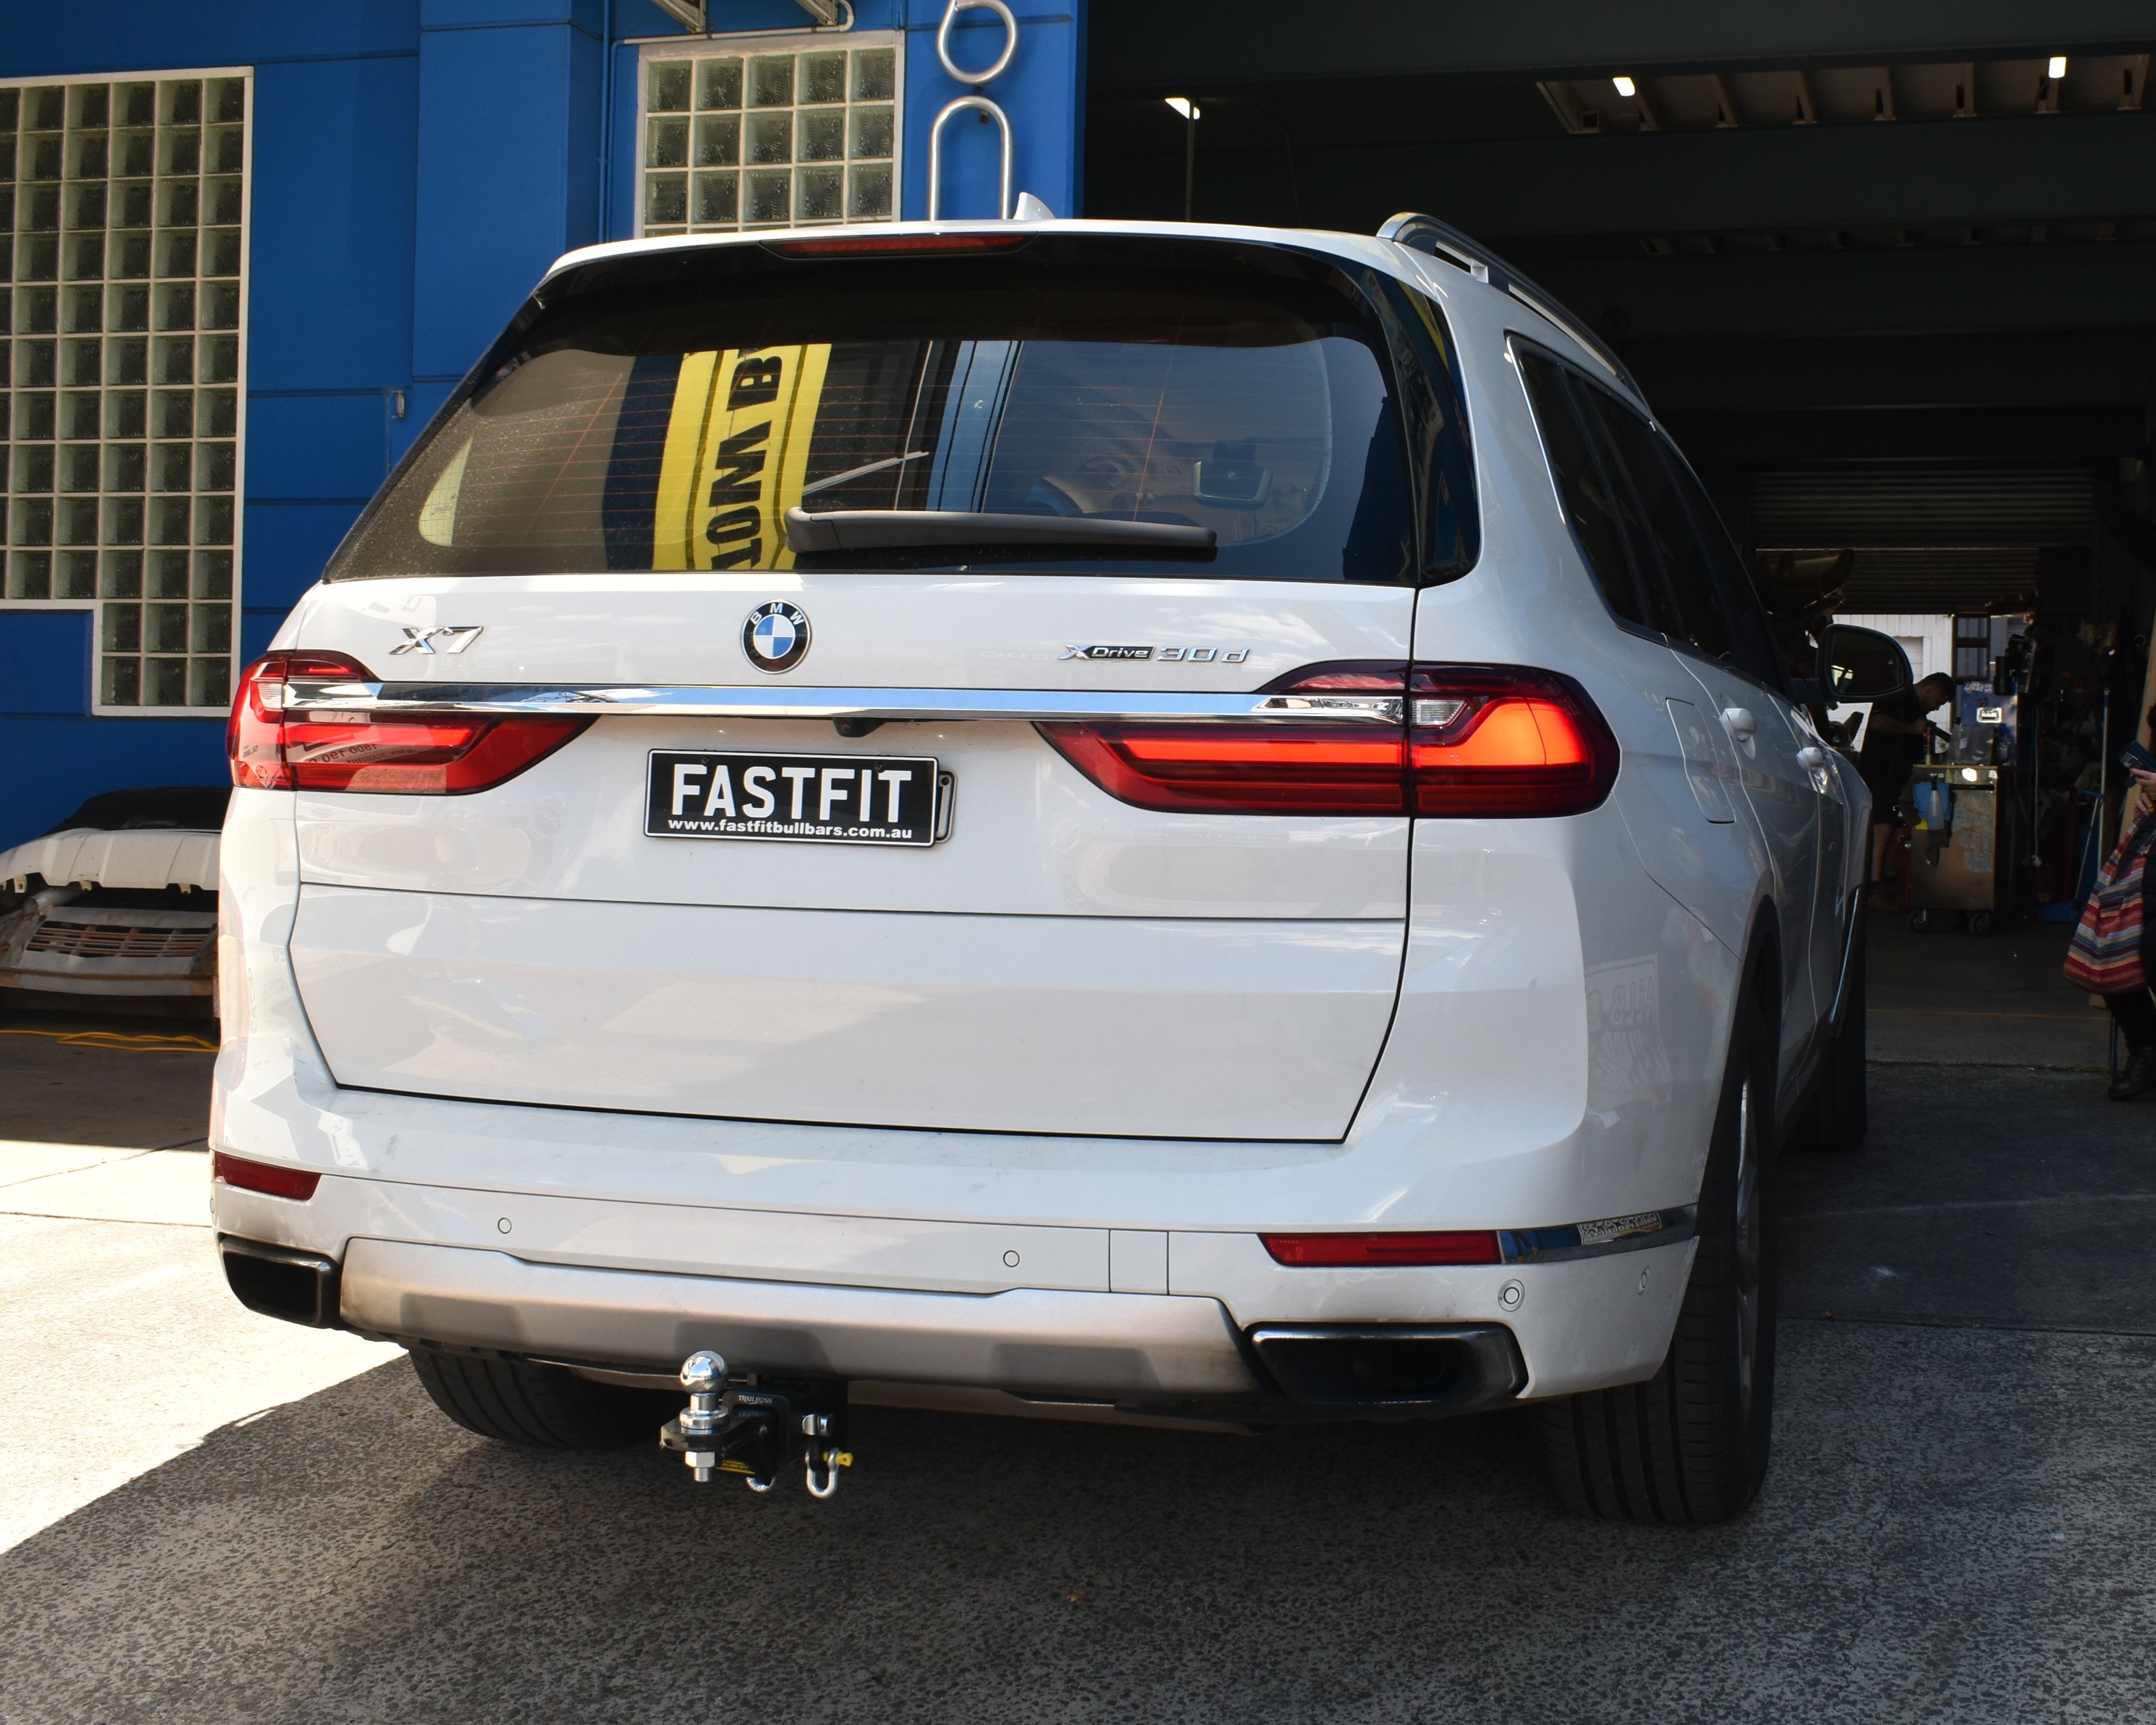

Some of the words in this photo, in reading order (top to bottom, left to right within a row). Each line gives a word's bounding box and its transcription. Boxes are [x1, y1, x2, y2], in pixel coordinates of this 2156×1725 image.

[750, 603, 805, 625] BMW
[389, 626, 484, 655] X7
[671, 763, 912, 823] FASTFIT
[668, 819, 912, 839] www.fastfitbullbars.com.au
